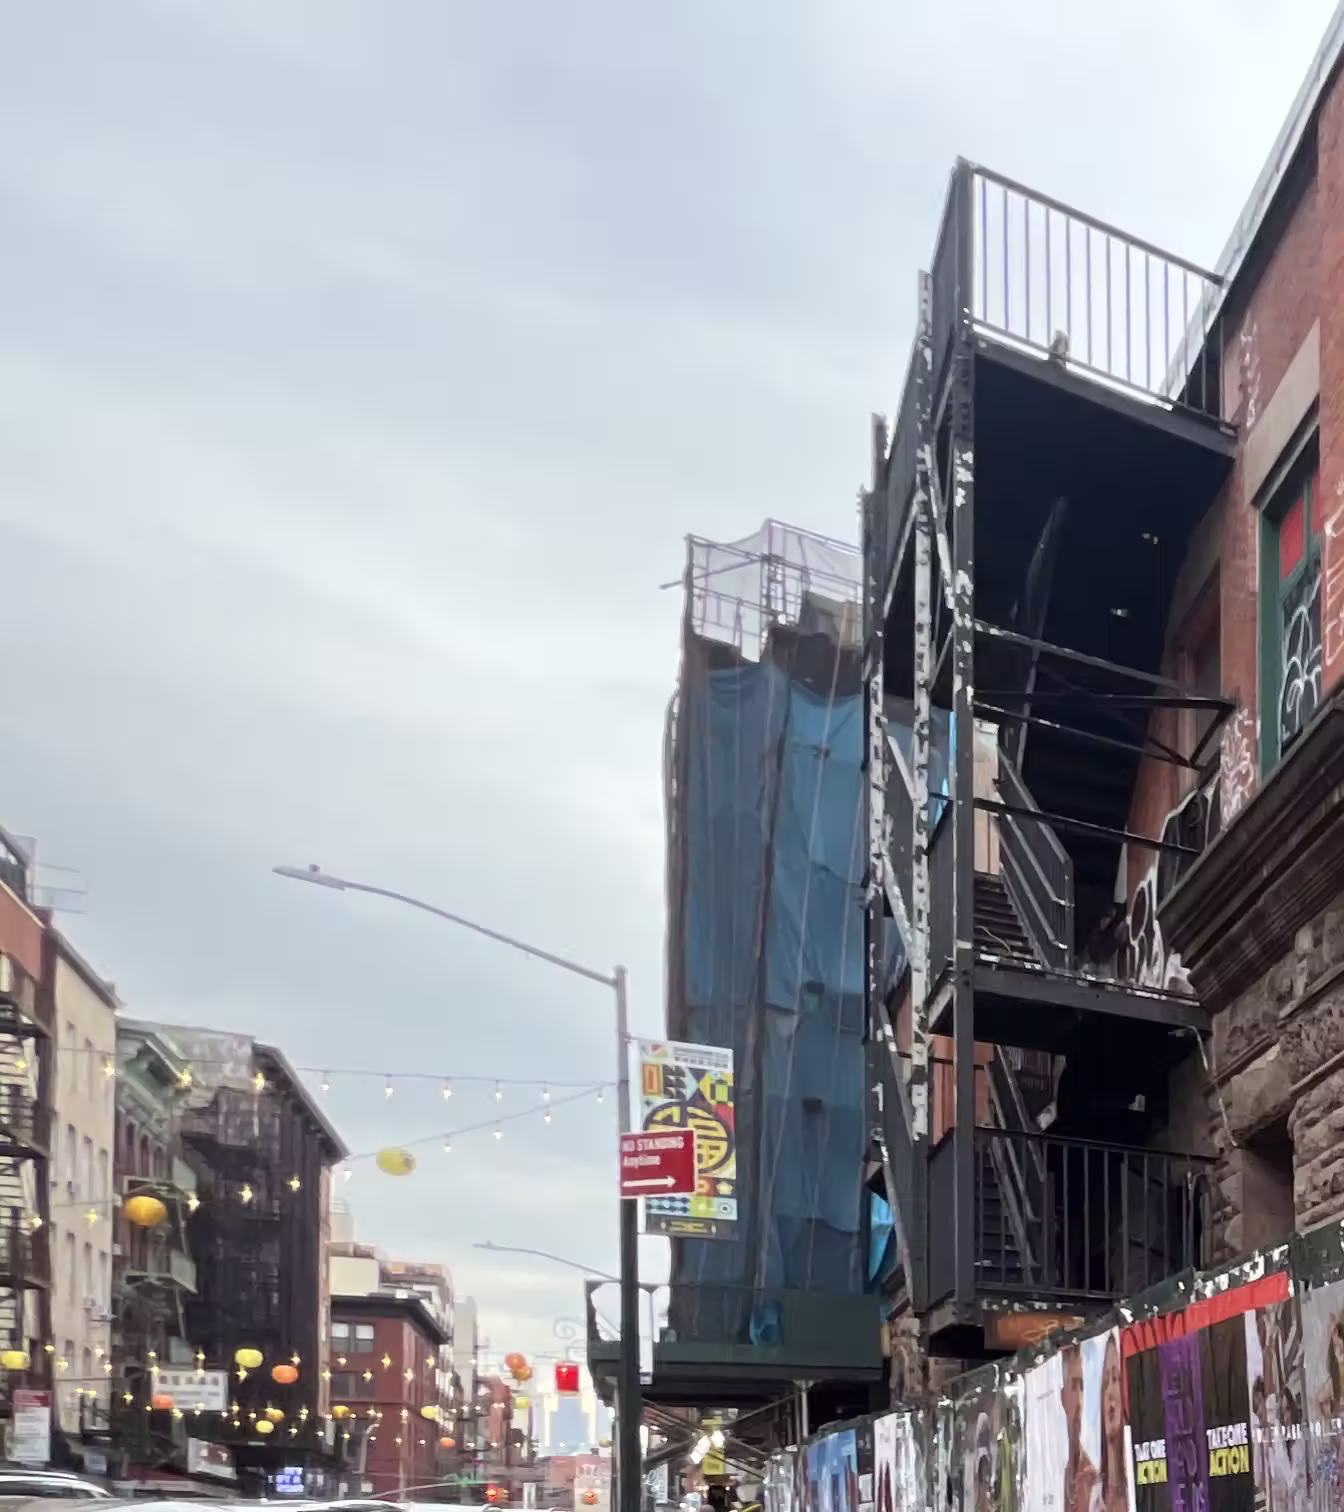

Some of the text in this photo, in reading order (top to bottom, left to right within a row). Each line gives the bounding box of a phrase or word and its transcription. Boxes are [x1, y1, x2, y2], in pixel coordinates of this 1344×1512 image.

[622, 1136, 684, 1152] NO STANDING
[623, 1154, 661, 1168] Anytime
[1209, 1445, 1250, 1477] ACTION
